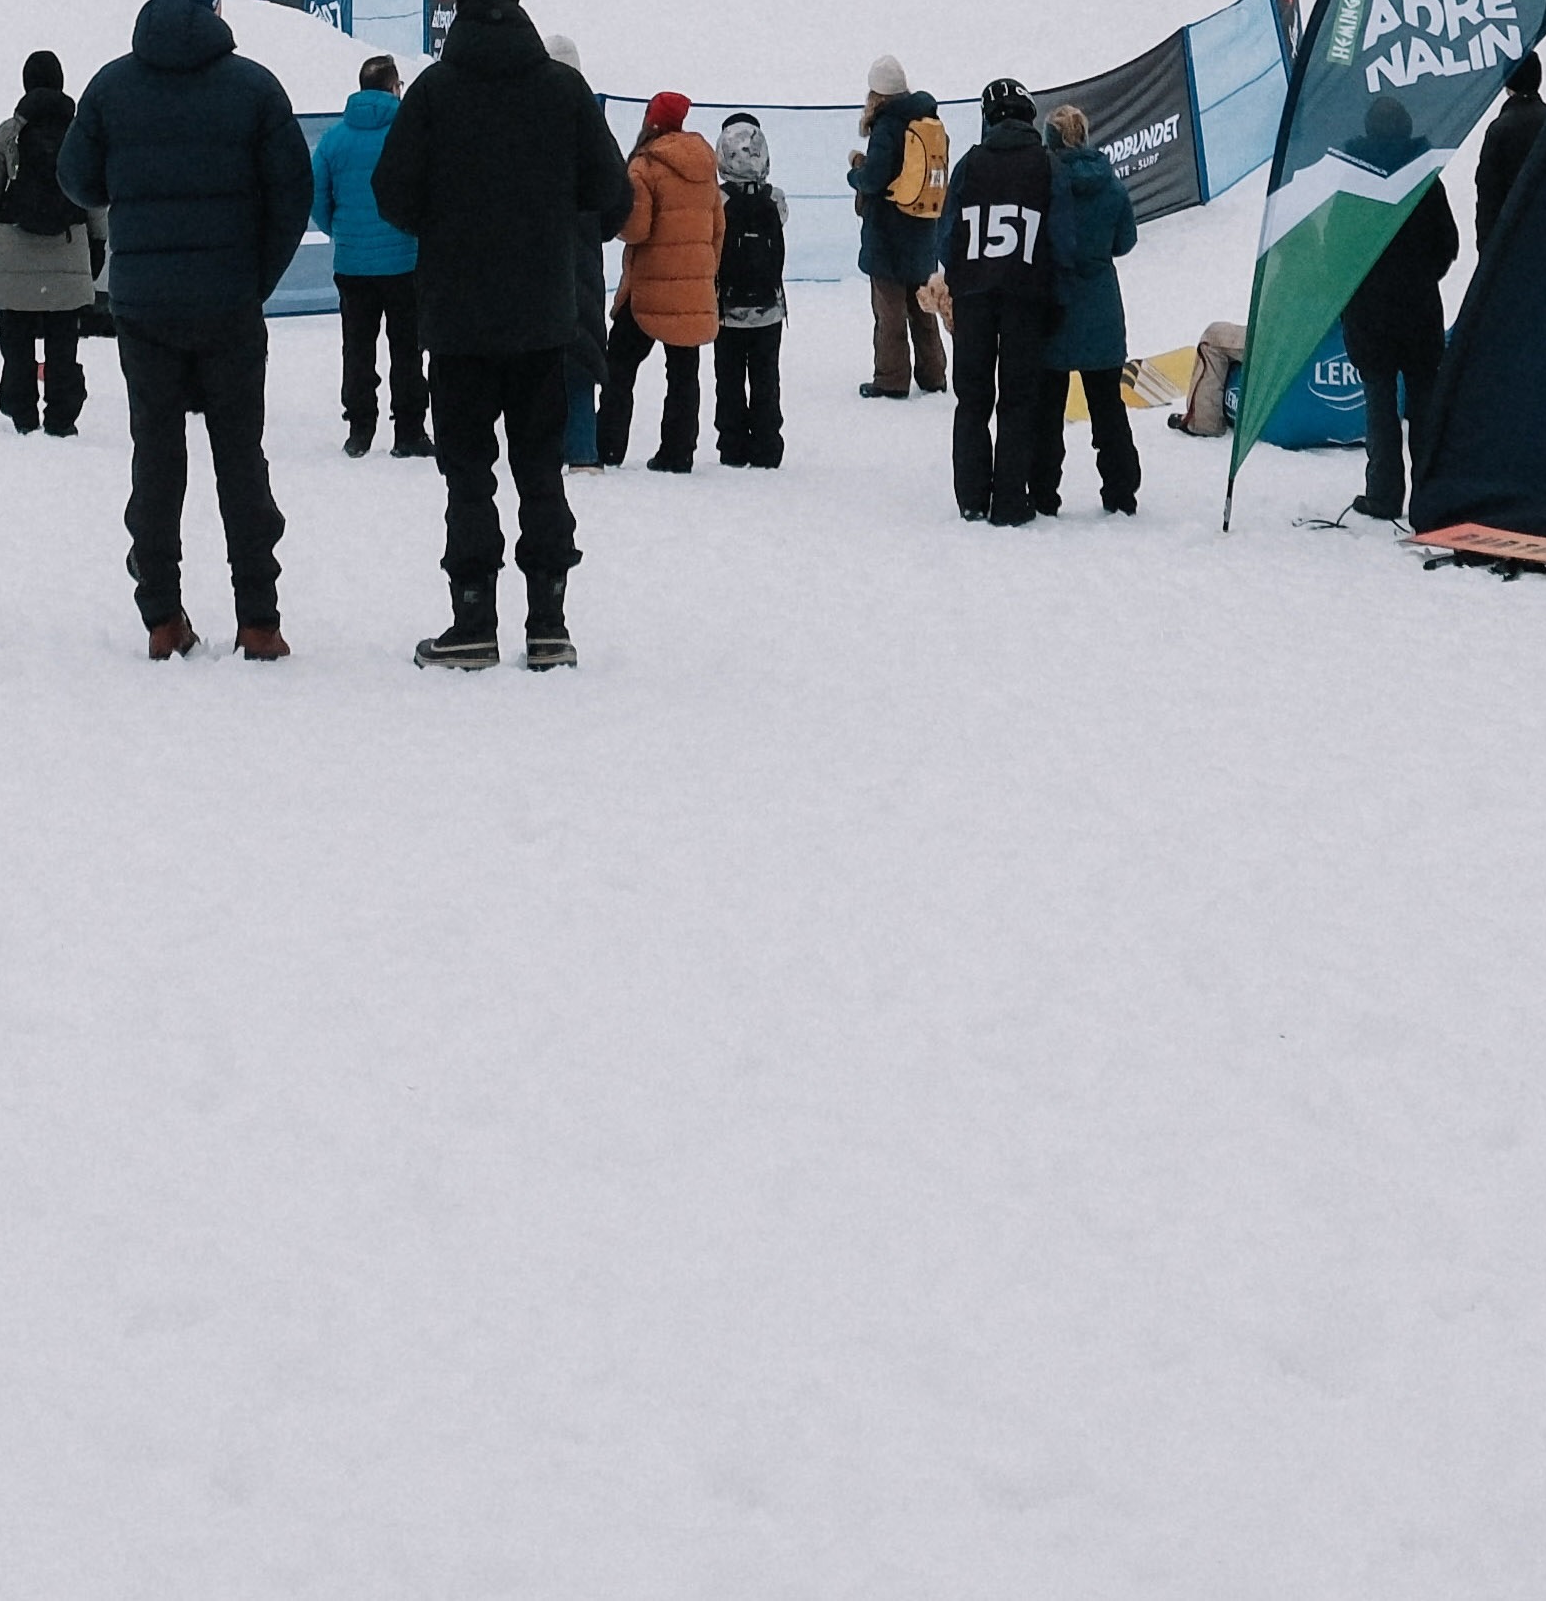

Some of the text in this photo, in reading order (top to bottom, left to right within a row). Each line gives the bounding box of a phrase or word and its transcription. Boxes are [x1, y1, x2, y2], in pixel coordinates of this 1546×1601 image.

[1365, 23, 1523, 93] NALIN
[1098, 113, 1181, 165] ORBUNDET
[1138, 153, 1160, 170] SURF
[962, 204, 1041, 265] 151
